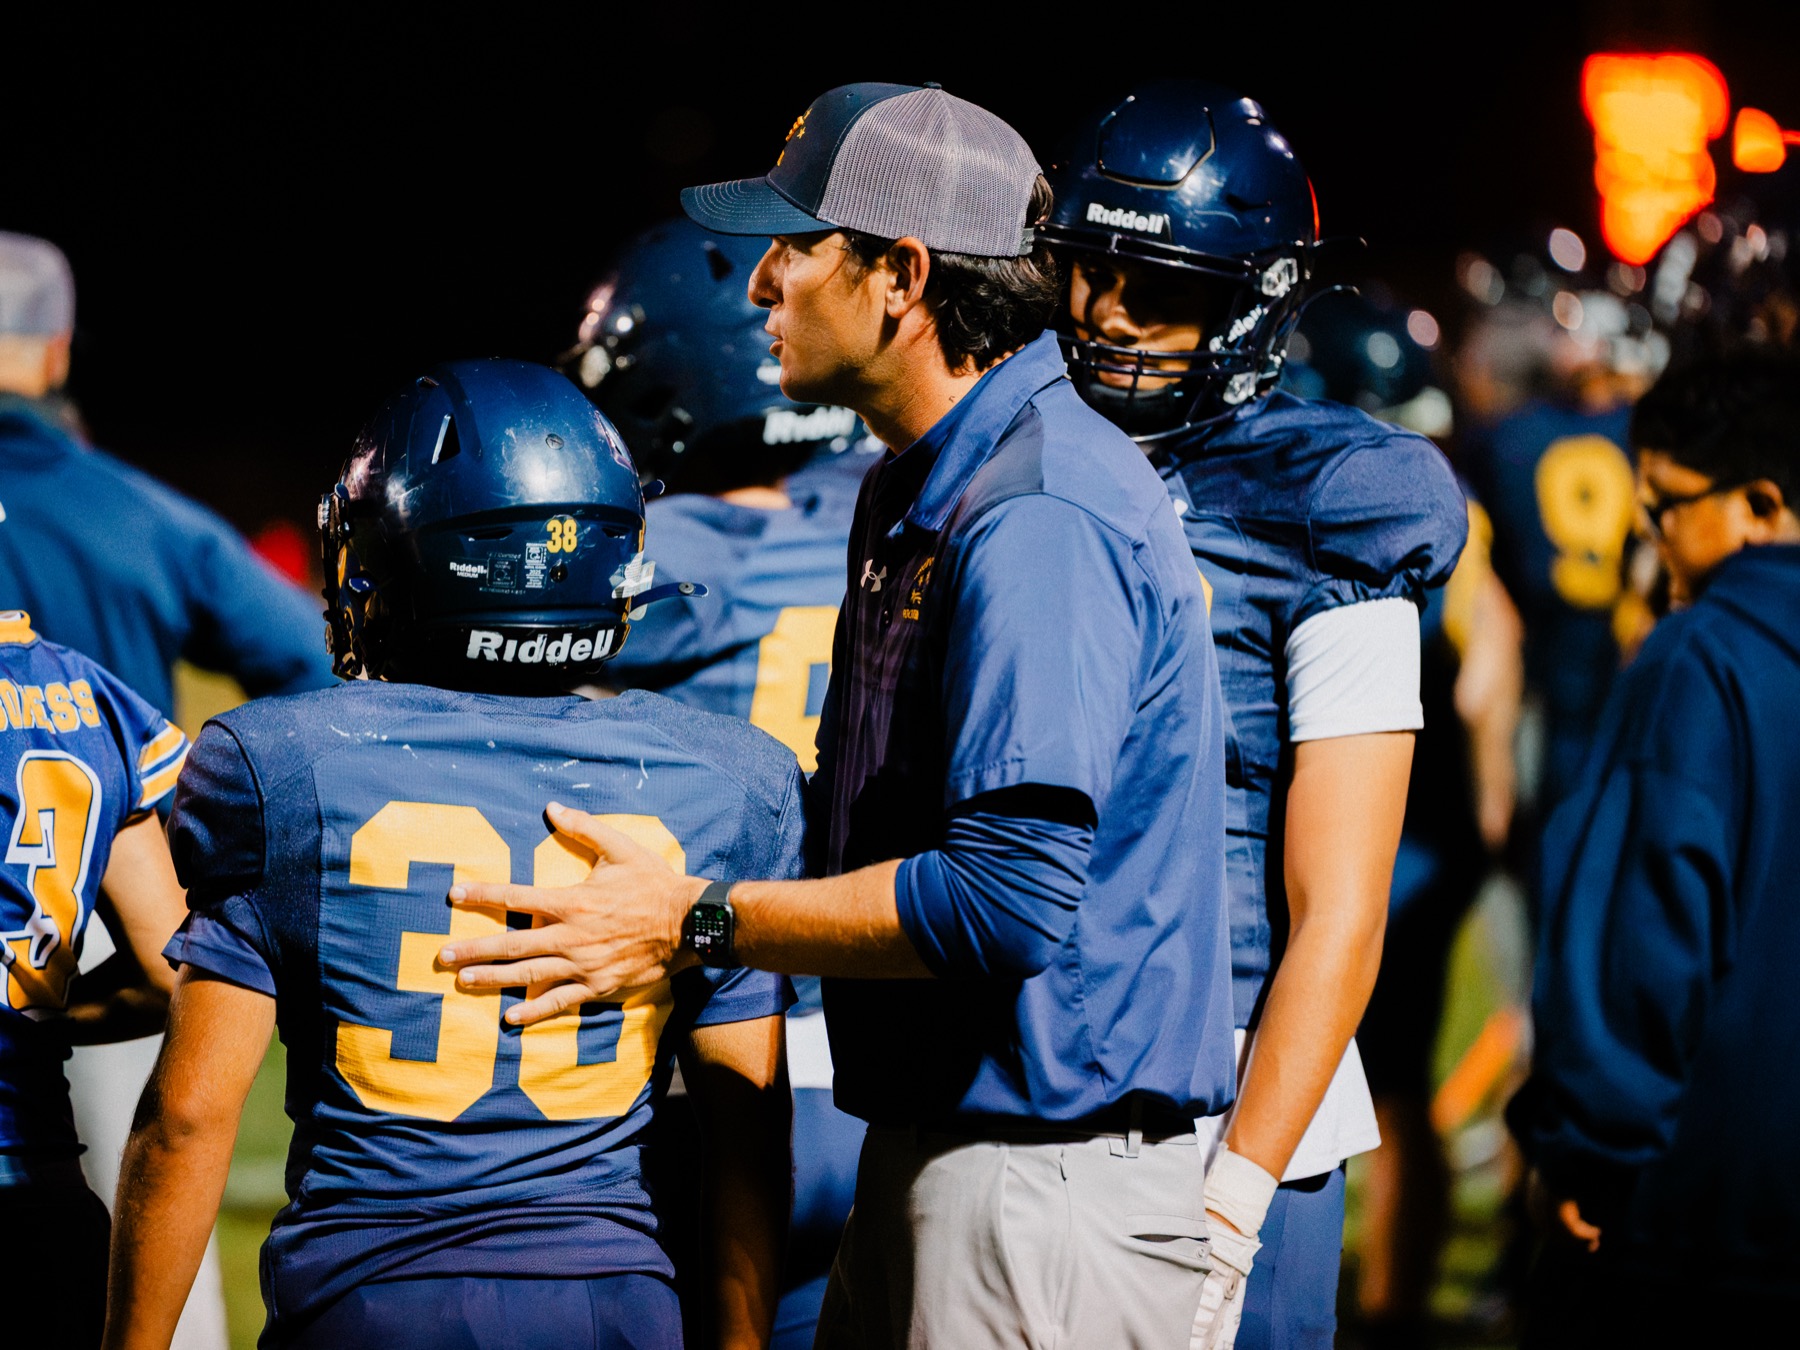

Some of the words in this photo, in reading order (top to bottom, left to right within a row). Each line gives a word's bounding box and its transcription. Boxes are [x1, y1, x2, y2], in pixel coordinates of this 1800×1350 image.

[1086, 202, 1165, 235] Riddell
[546, 519, 578, 553] 38
[449, 561, 484, 574] Riddell
[465, 628, 615, 664] Riddell
